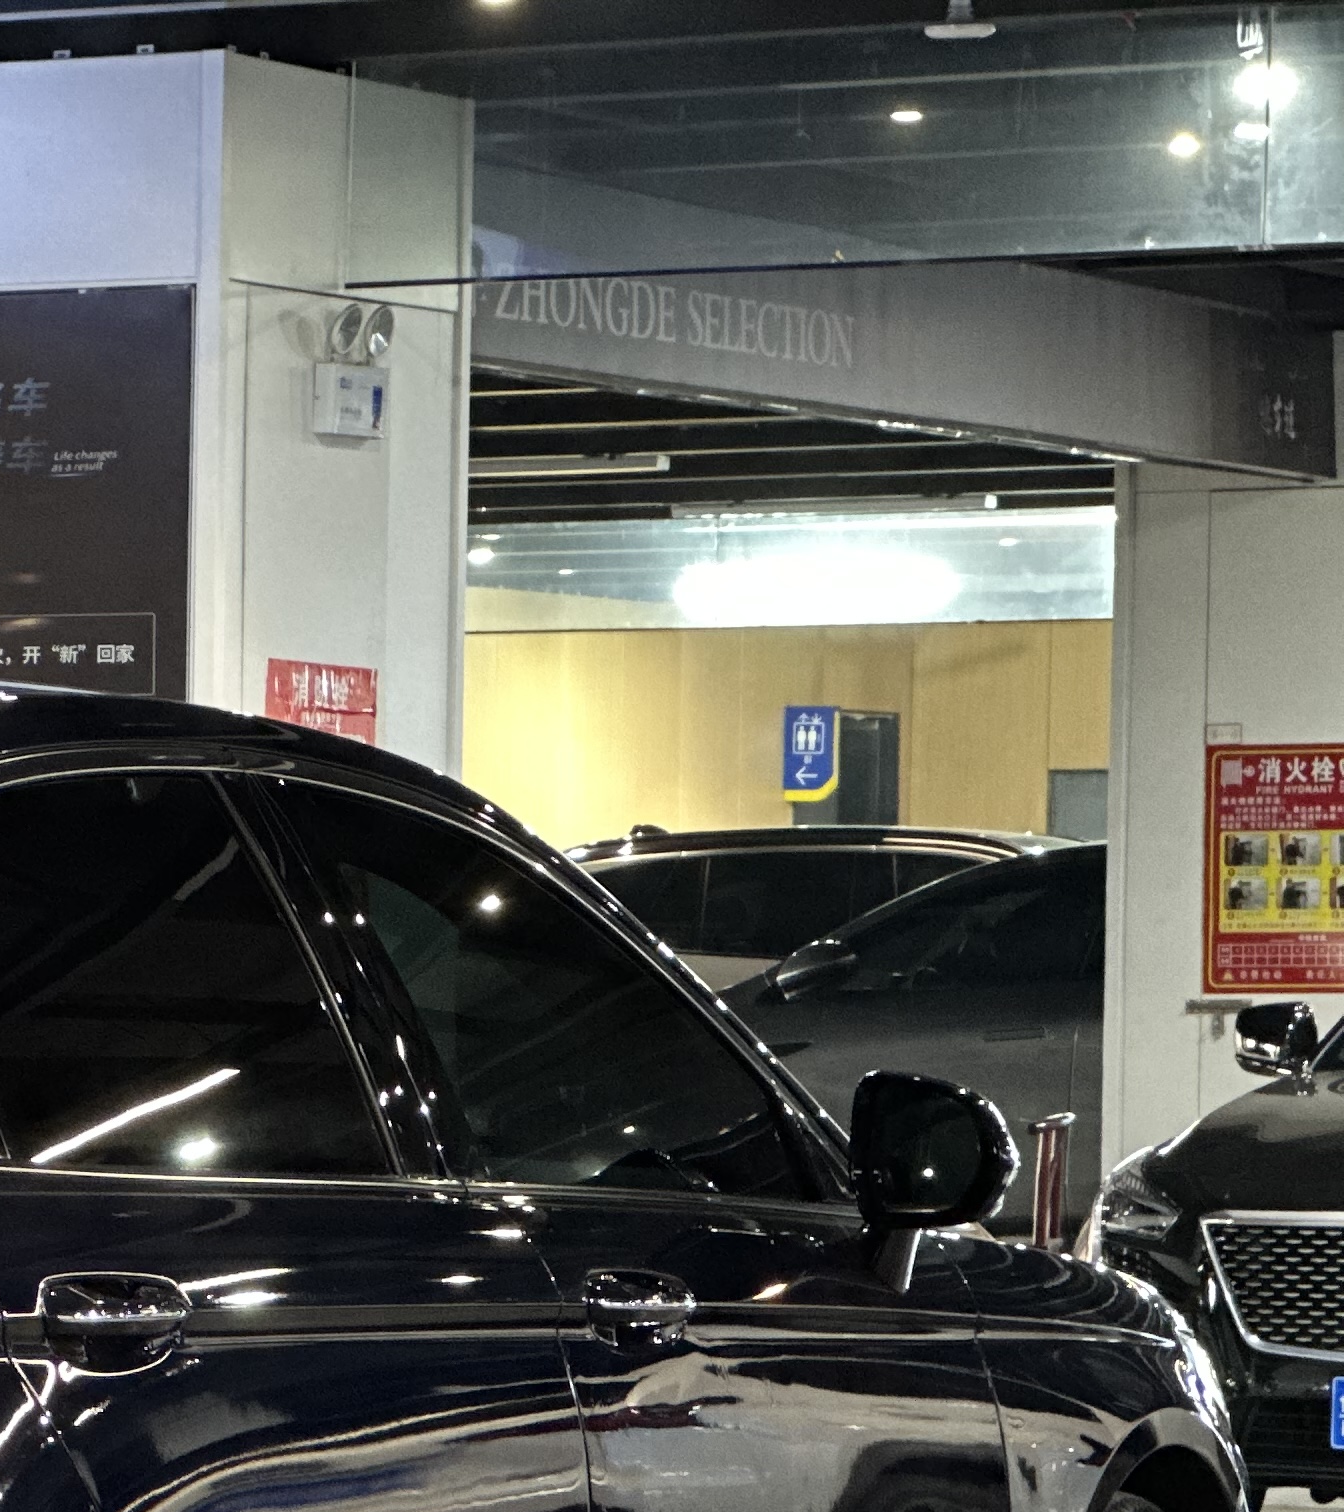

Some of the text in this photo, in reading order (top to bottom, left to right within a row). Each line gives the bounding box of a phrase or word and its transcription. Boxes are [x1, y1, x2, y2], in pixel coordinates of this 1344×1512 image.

[495, 278, 856, 369] ZHONGDE SELECTION
[1258, 756, 1336, 783] 消火栓
